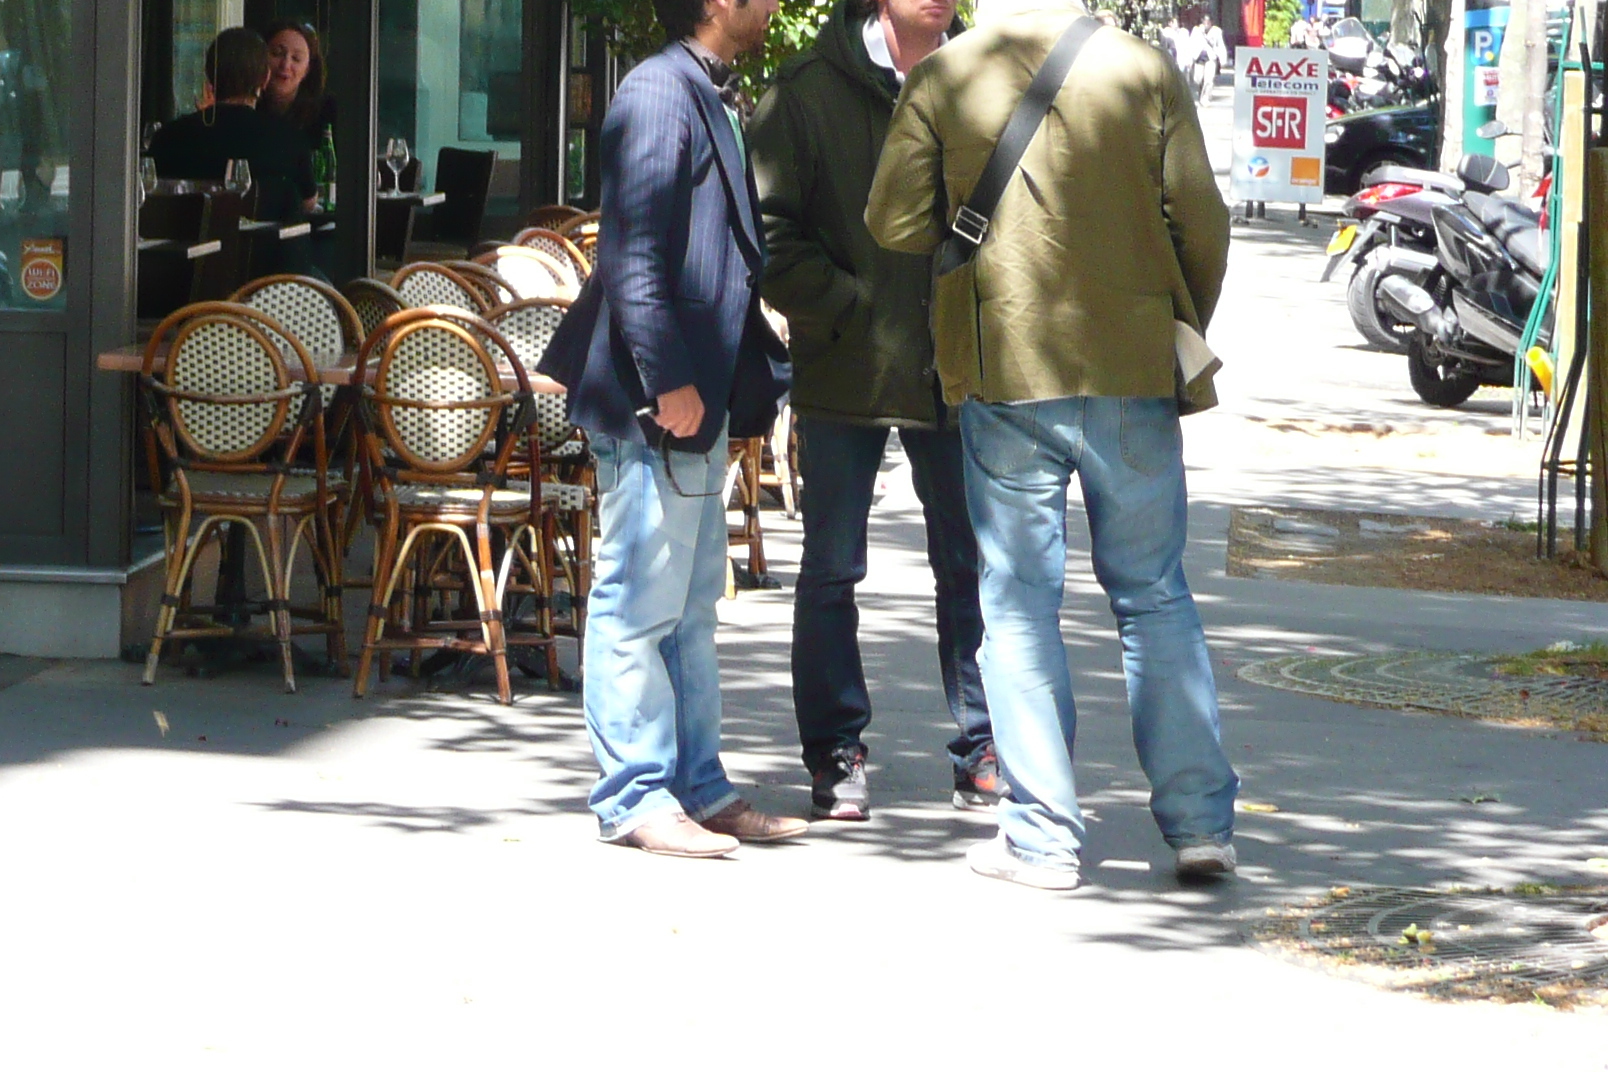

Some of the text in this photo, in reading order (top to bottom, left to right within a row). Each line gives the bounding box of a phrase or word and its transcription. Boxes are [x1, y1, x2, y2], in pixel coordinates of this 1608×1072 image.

[1246, 56, 1320, 80] AAXE
[1245, 75, 1319, 90] Telecom
[1256, 105, 1302, 140] SFR
